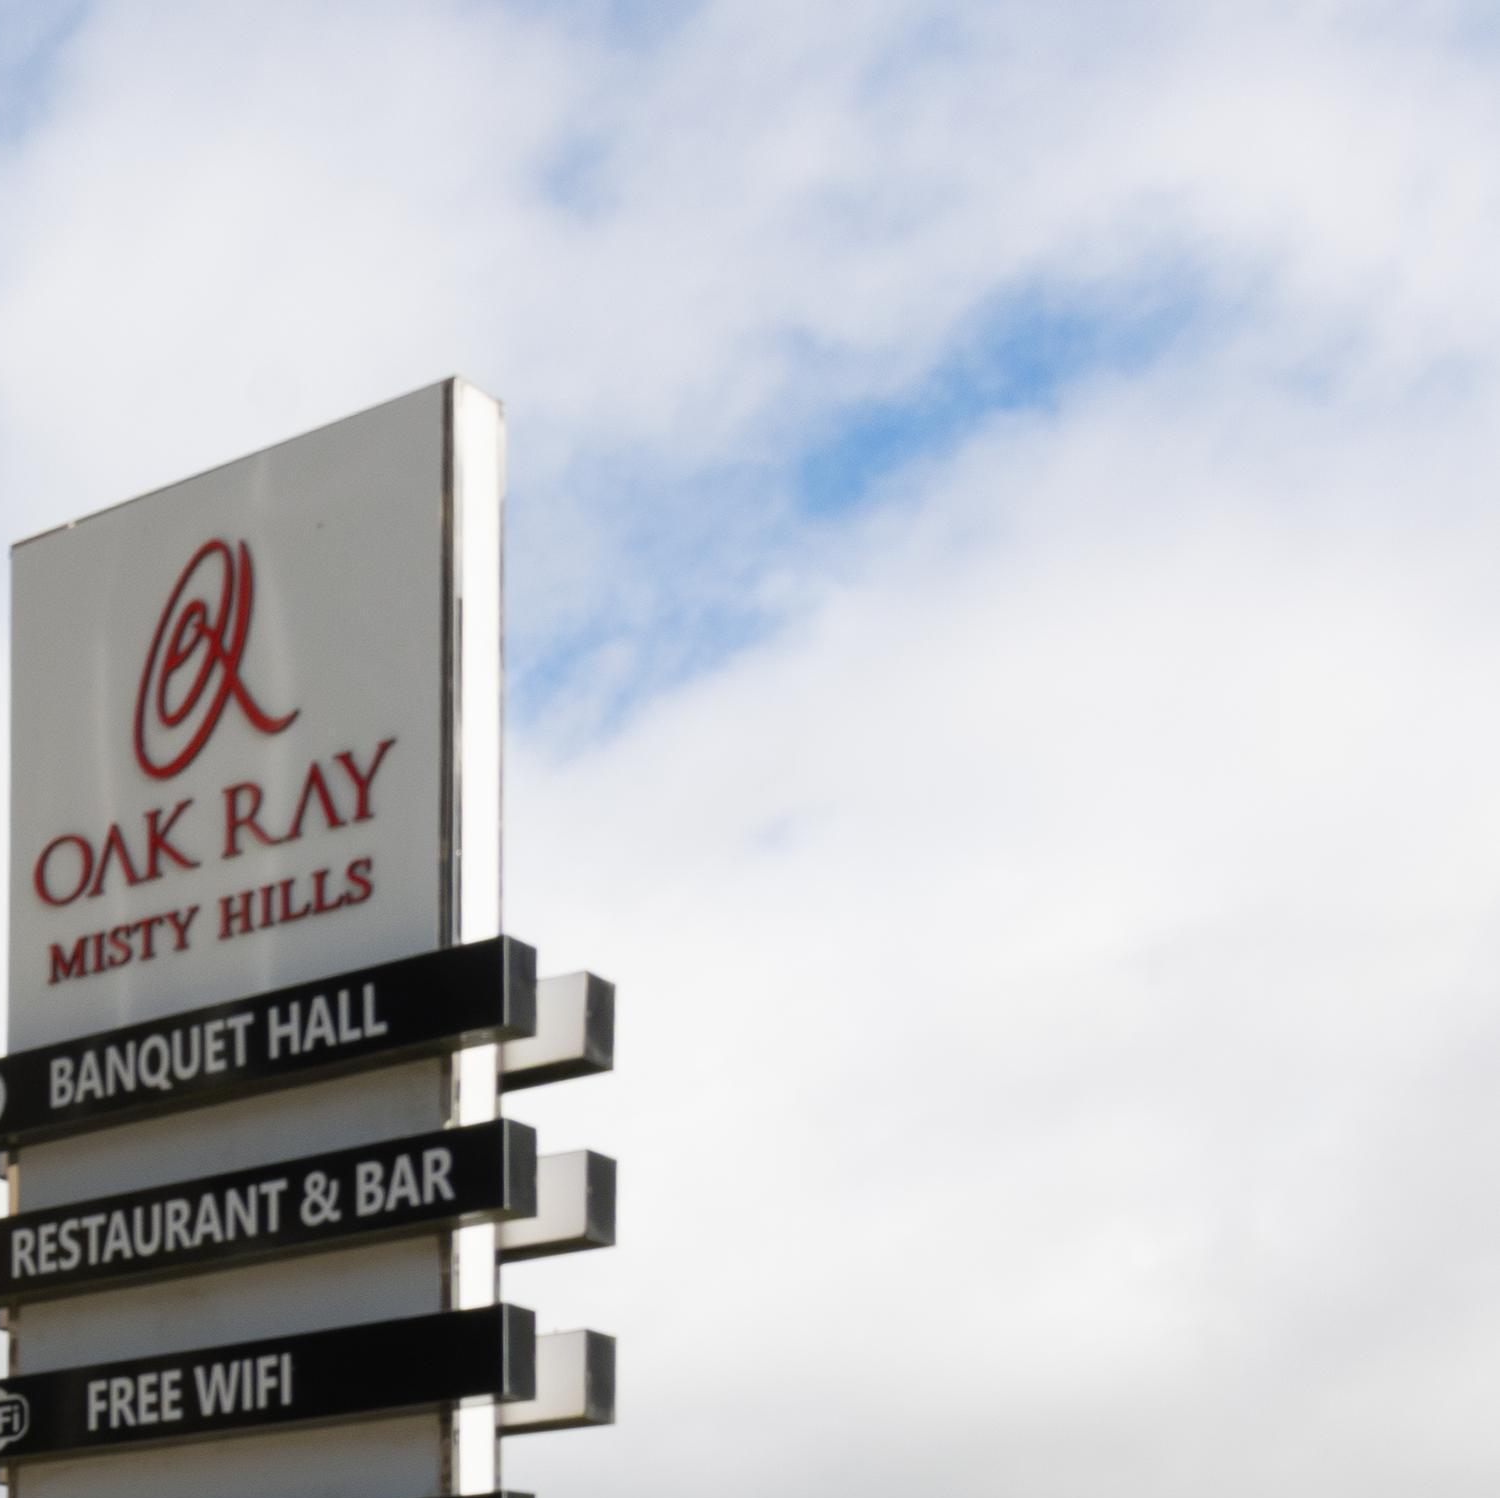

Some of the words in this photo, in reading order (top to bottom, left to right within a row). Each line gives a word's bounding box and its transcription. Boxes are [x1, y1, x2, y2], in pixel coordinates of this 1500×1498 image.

[32, 799, 201, 907] OAK
[221, 739, 396, 859] RAY
[47, 905, 201, 984] MISTY
[217, 857, 374, 940] HILLS
[49, 1014, 255, 1109] BANQUET
[268, 982, 388, 1059] HALL
[10, 1180, 287, 1279] RESTAURANT
[300, 1170, 342, 1227] &
[356, 1147, 455, 1217] BAR
[87, 1369, 184, 1432] FREE
[194, 1353, 293, 1417] WIFI
